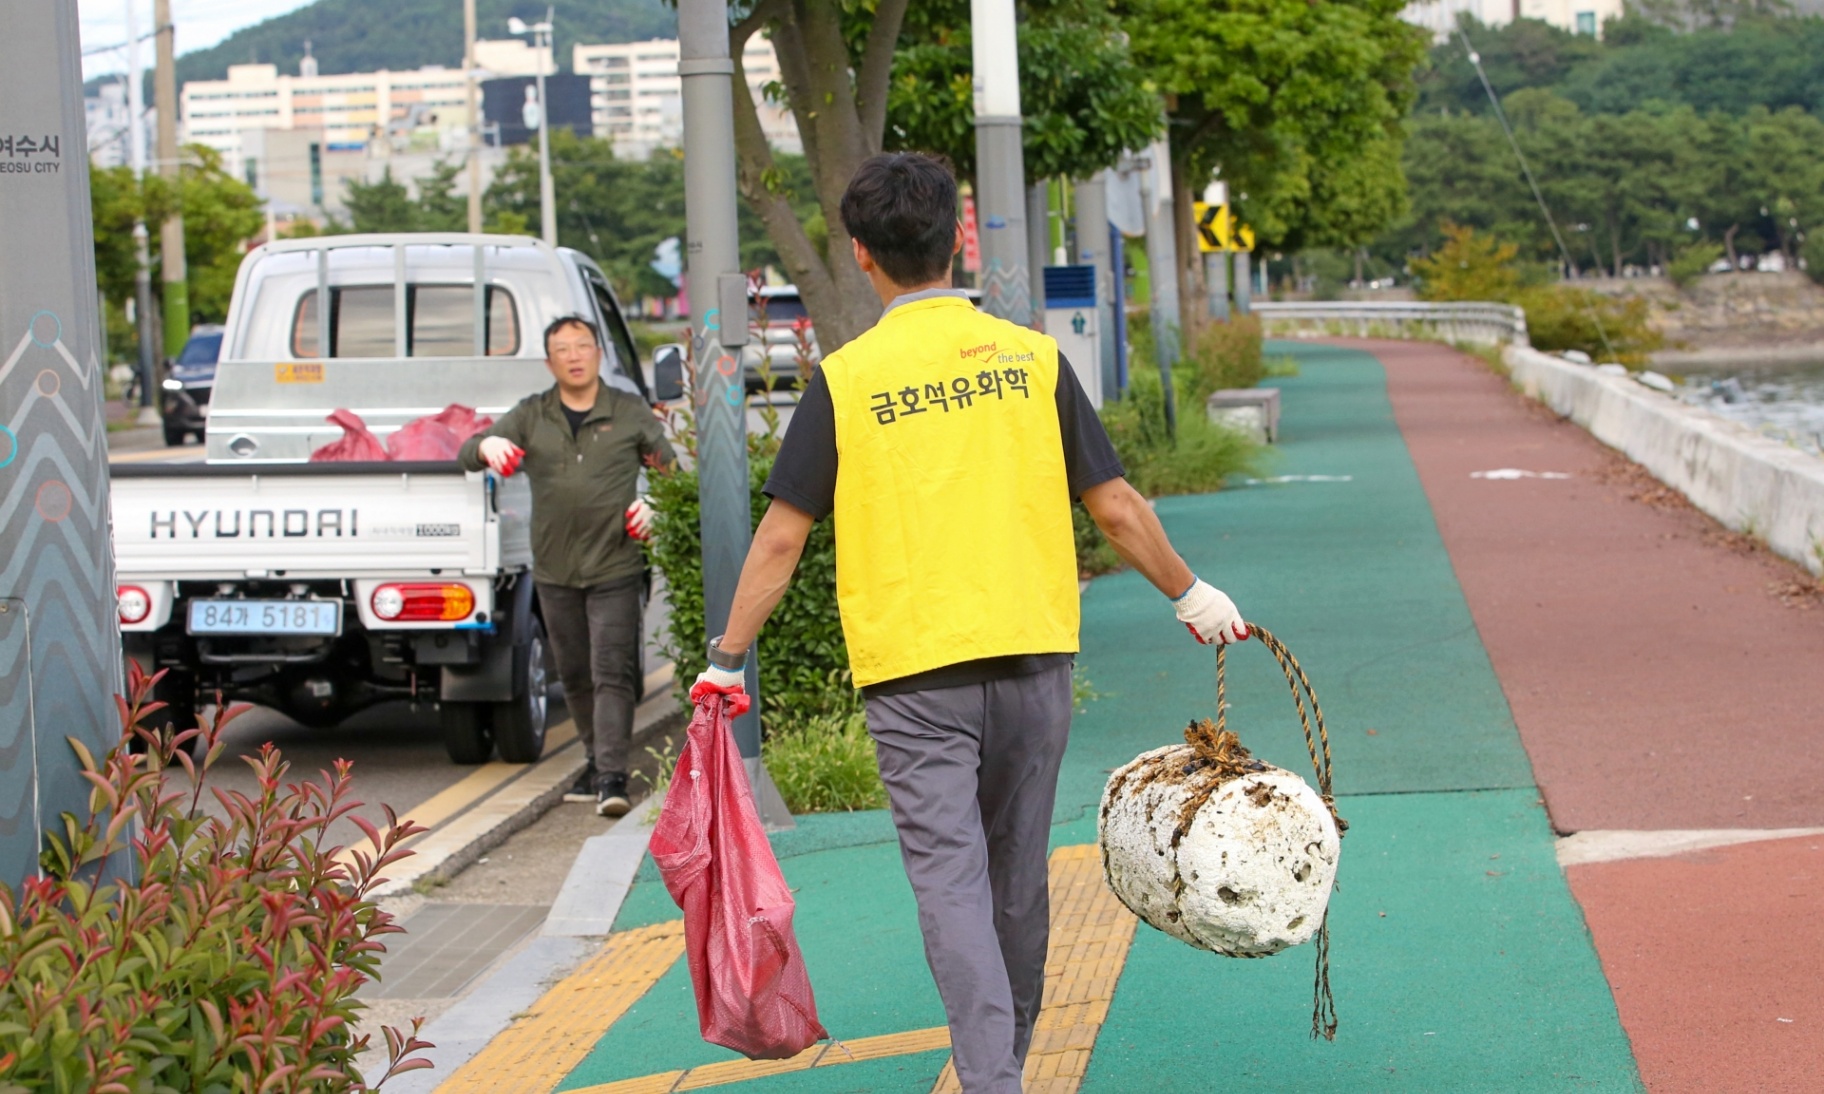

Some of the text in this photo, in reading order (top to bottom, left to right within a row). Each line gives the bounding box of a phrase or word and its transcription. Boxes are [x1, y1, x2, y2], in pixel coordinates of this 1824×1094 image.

[0, 134, 60, 158] 여수시
[34, 161, 60, 173] CITY
[960, 341, 997, 359] beyond
[997, 351, 1035, 364] the best
[870, 367, 1030, 426] 금호석유화학
[150, 509, 358, 538] HYUNDAI
[203, 604, 320, 629] 84가 5181
